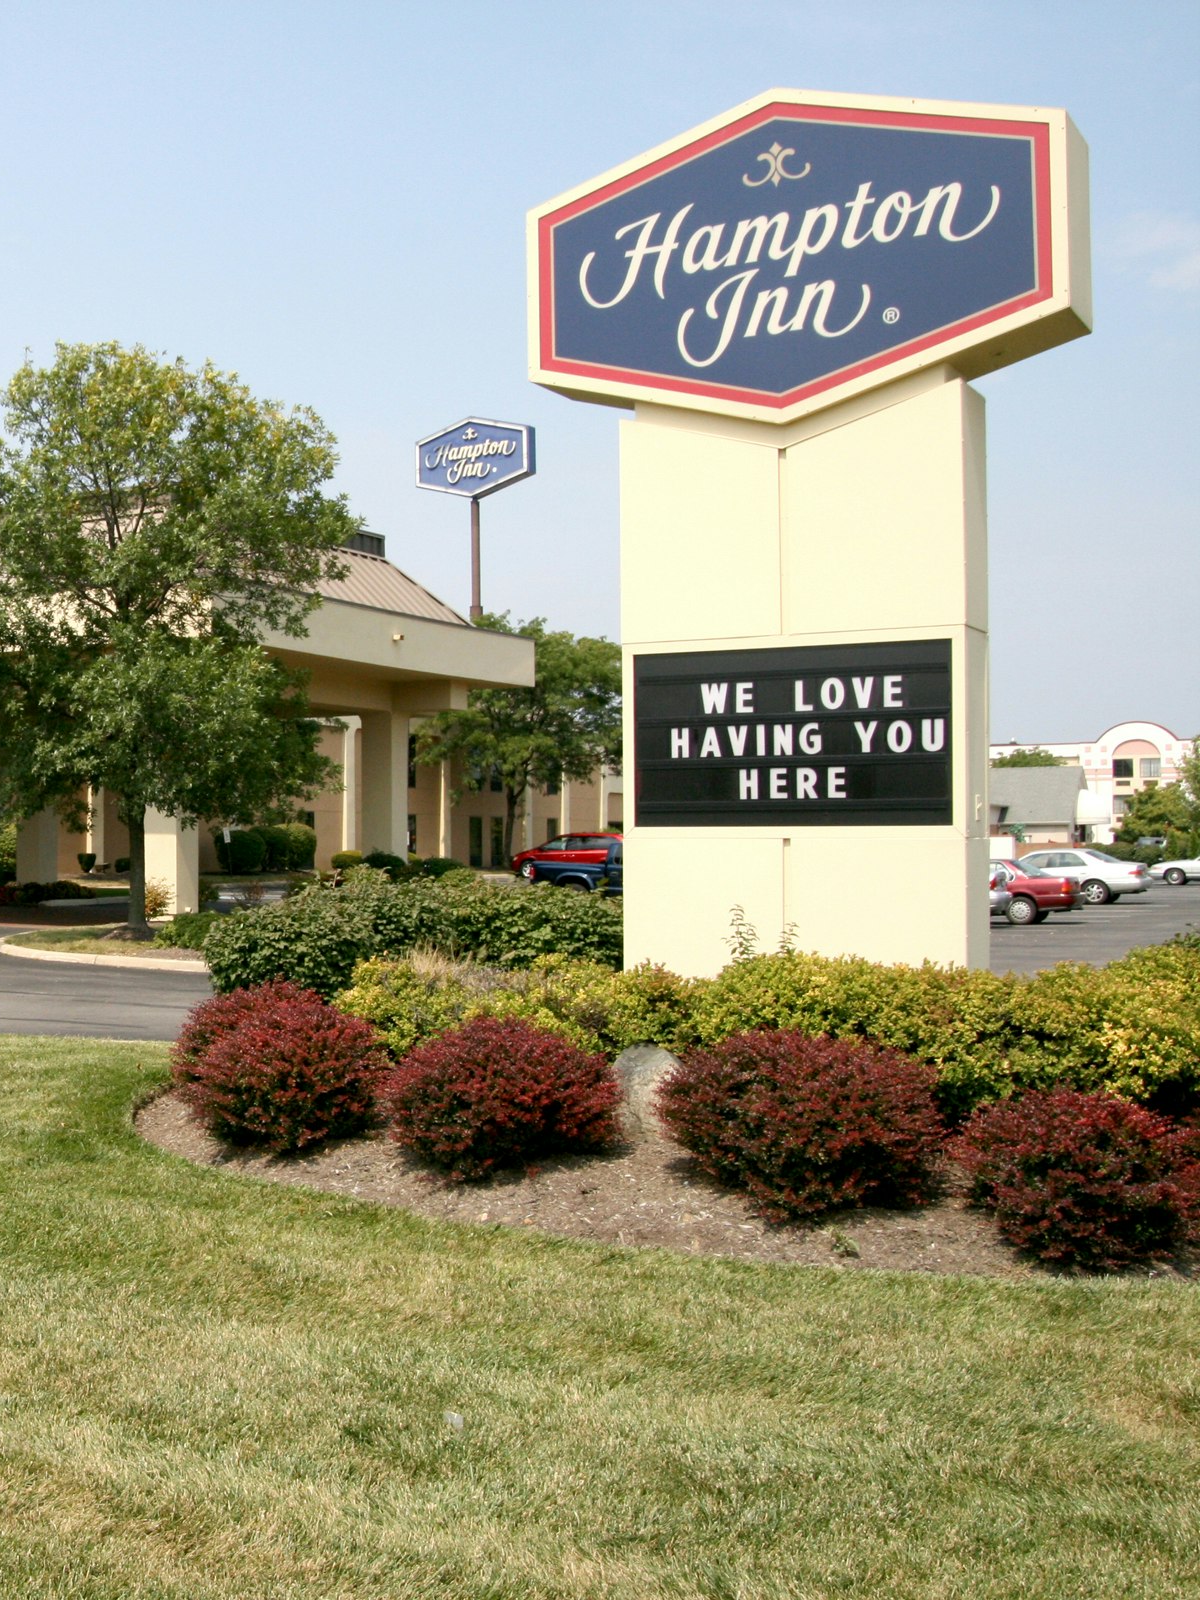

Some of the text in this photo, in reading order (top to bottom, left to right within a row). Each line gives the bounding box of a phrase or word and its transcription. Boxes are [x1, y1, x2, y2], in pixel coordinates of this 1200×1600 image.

[579, 181, 1000, 310] Hampton
[677, 268, 872, 367] Inn
[425, 439, 516, 469] Hampton
[447, 459, 491, 484] Inn
[700, 675, 903, 714] WE LOVE
[670, 718, 945, 759] HAVING YOU
[738, 766, 847, 800] HERE
